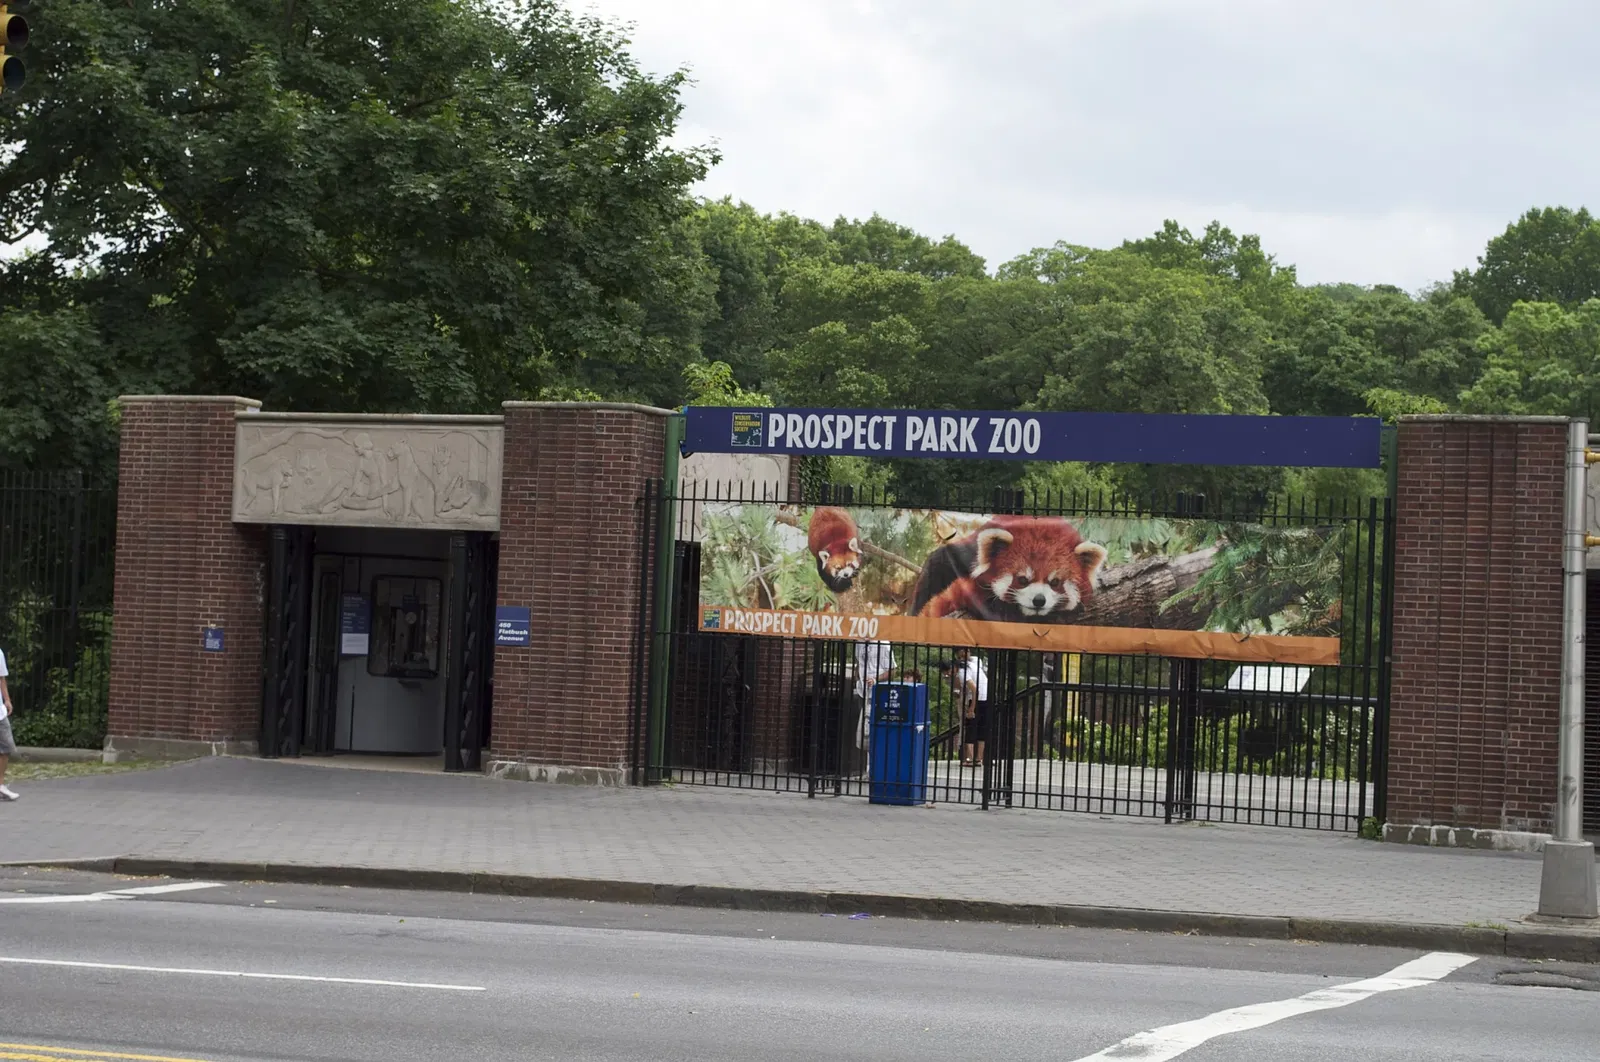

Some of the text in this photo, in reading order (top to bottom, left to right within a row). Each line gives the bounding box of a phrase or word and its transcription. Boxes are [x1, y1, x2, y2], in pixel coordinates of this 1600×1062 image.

[768, 413, 1041, 454] PROSPECT PARK ZOO
[724, 609, 797, 634] PROSPECT
[802, 614, 844, 637] PARK
[848, 616, 879, 638] ZOO
